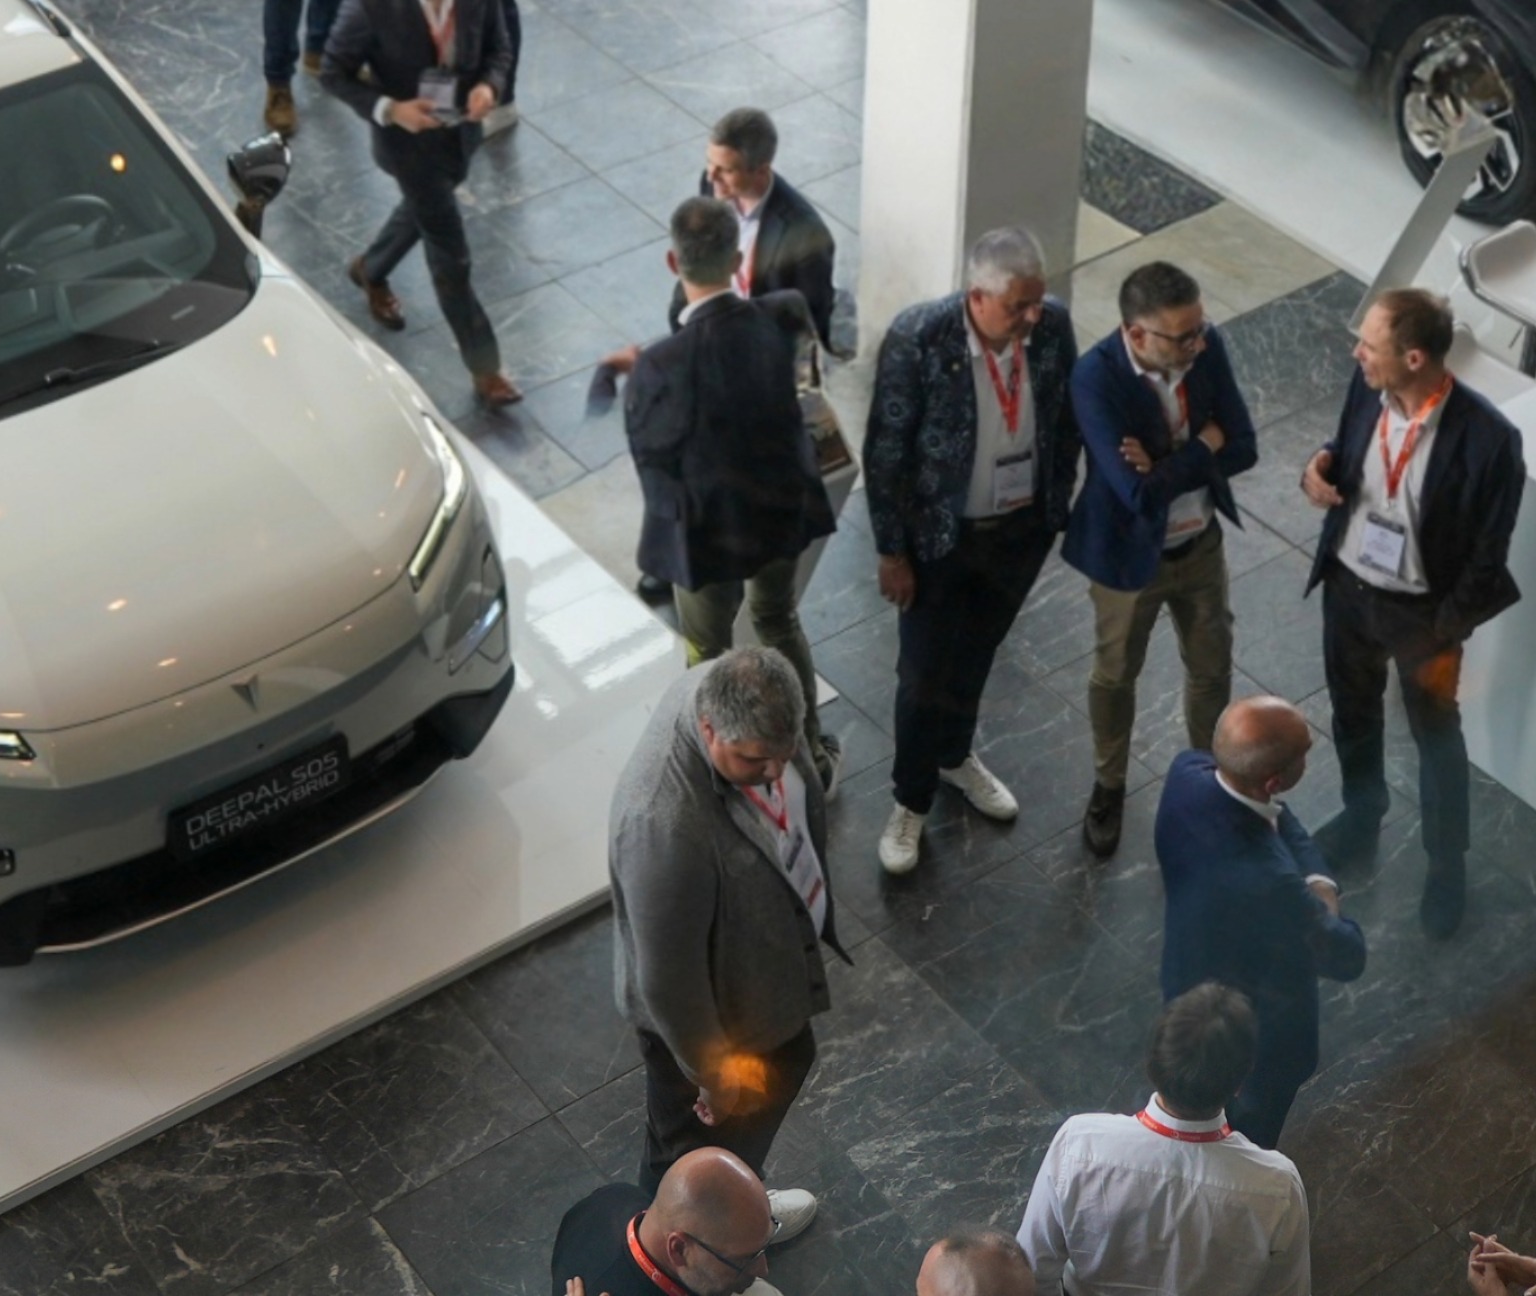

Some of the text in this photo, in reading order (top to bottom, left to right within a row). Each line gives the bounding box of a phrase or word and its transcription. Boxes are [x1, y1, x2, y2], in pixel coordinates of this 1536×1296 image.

[185, 751, 338, 835] DEEPAL S05
[189, 770, 339, 851] ULTRA-HYBRID
